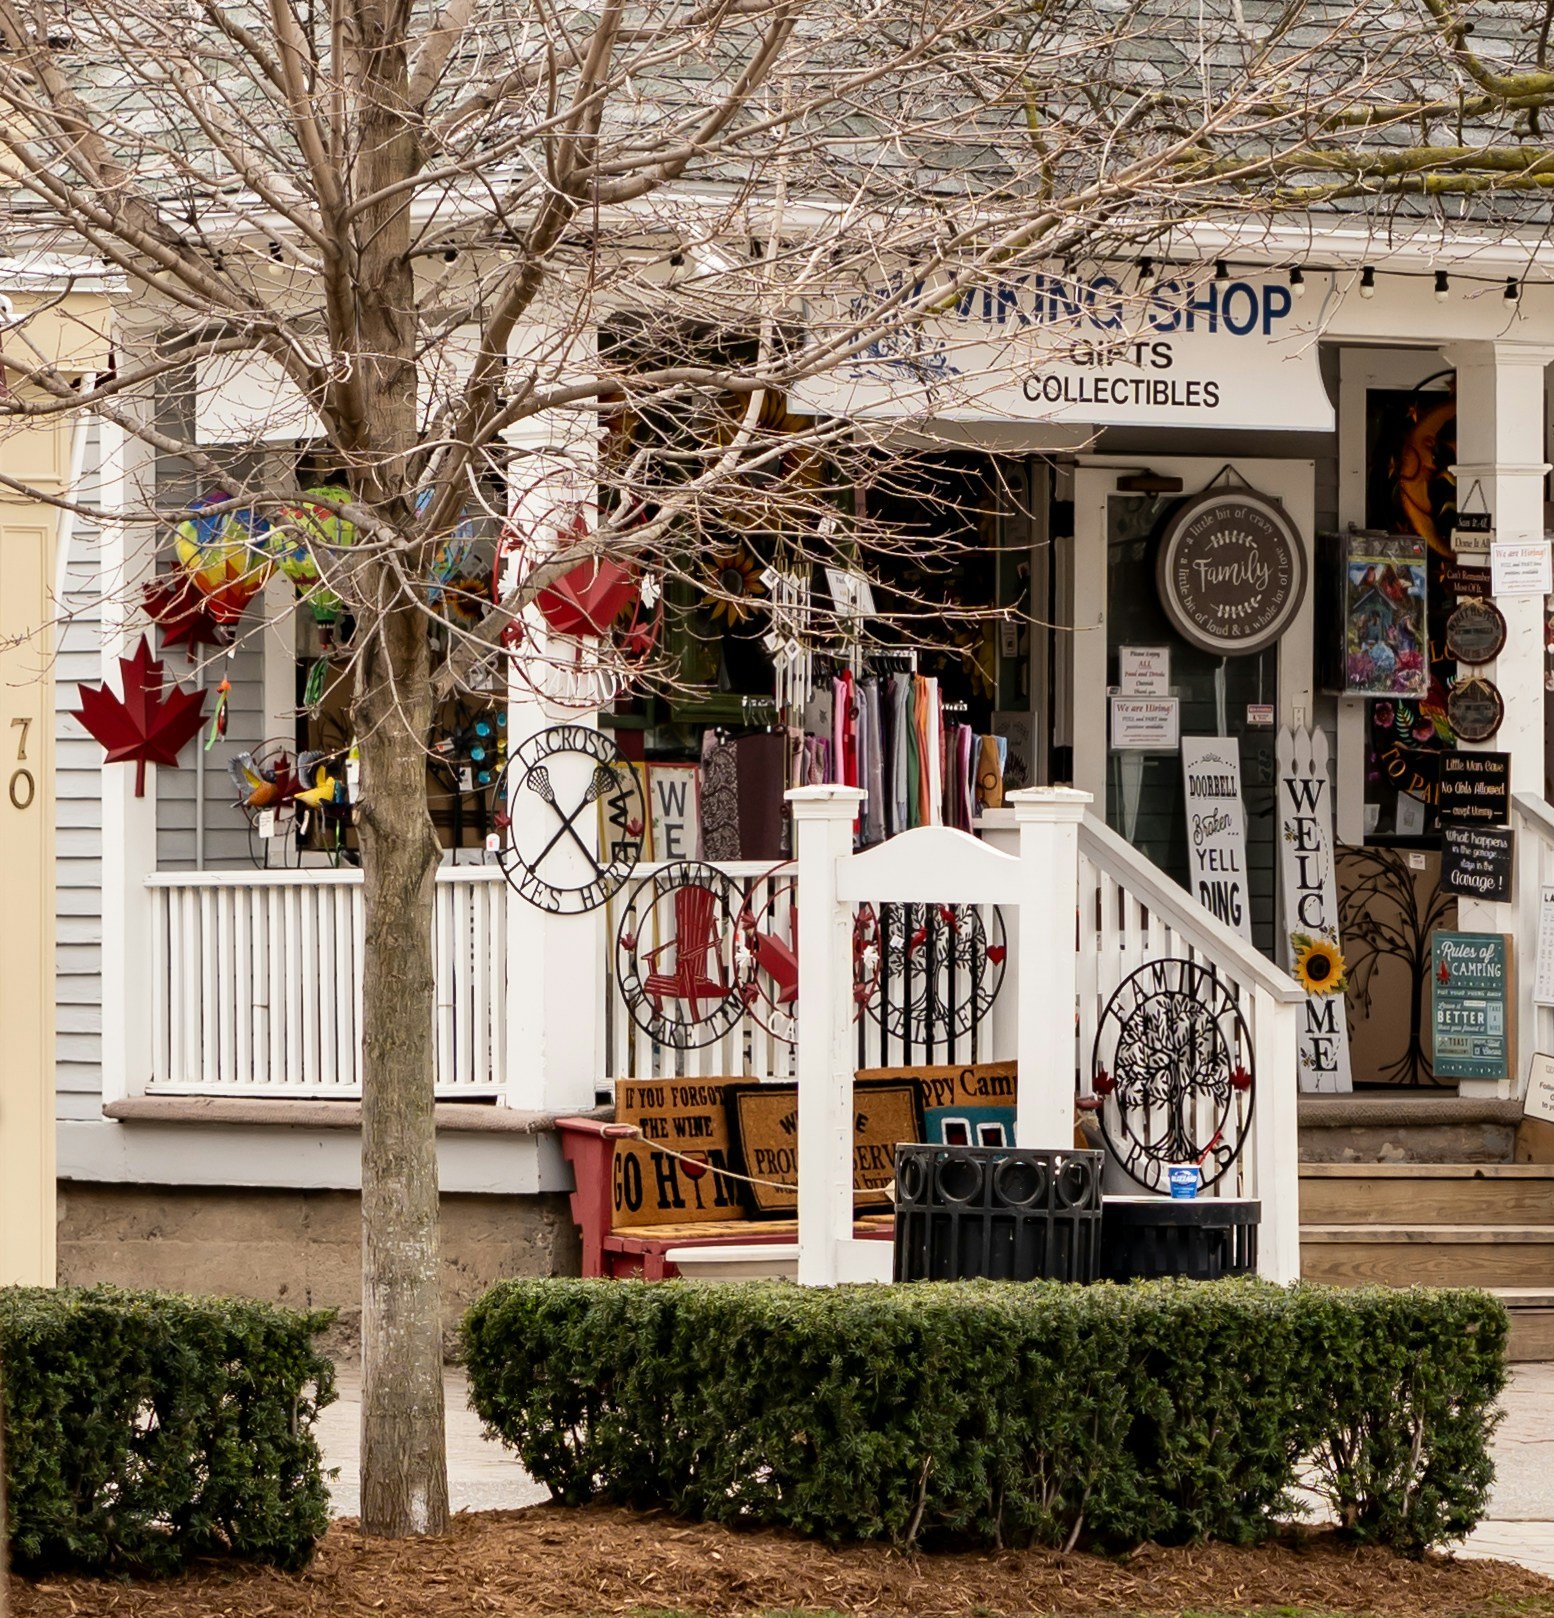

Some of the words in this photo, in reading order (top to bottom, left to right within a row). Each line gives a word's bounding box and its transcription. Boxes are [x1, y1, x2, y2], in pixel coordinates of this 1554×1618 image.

[949, 269, 1124, 331] VIKING
[1149, 279, 1292, 336] SHOP
[1071, 339, 1173, 370] GIFTS
[1023, 374, 1220, 408] COLLECTIBLES
[1189, 515, 1214, 536] little
[1216, 509, 1230, 520] bit
[1234, 508, 1247, 518] of
[1249, 513, 1274, 535] crazy
[1275, 547, 1289, 569] love
[1178, 568, 1190, 596] little
[1193, 550, 1274, 593] Family
[1278, 574, 1288, 587] of
[1183, 595, 1196, 613] bit
[1271, 589, 1285, 604] lot
[1194, 612, 1208, 624] of
[1206, 619, 1229, 636] loud
[1252, 605, 1278, 630] whole
[1231, 623, 1241, 636] &
[1117, 704, 1130, 712] We
[1146, 703, 1173, 715] Hiring!
[1446, 759, 1464, 771] Little
[1485, 760, 1504, 772] Cave
[1189, 775, 1237, 797] DOORBELL
[1441, 782, 1453, 793] No
[1474, 782, 1505, 795] Allowed
[1445, 830, 1470, 841] What
[1470, 832, 1508, 848] happens
[1196, 849, 1239, 872] YELL
[498, 847, 562, 912] LIVES
[580, 855, 639, 911] HERE
[1199, 880, 1241, 927] DING
[1441, 941, 1477, 961] Rules
[1479, 943, 1495, 963] of
[1452, 962, 1501, 977] CAMPING
[1437, 1011, 1485, 1024] BETTER
[645, 1012, 696, 1048] LAKE
[626, 1088, 635, 1109] IF
[638, 1087, 664, 1108] YOU
[671, 1085, 725, 1108] FORGOT
[921, 1078, 955, 1107] ppy
[960, 1069, 1017, 1097] Cam
[639, 1115, 669, 1139] THE
[672, 1116, 713, 1138] WINE
[614, 1151, 643, 1213] GO
